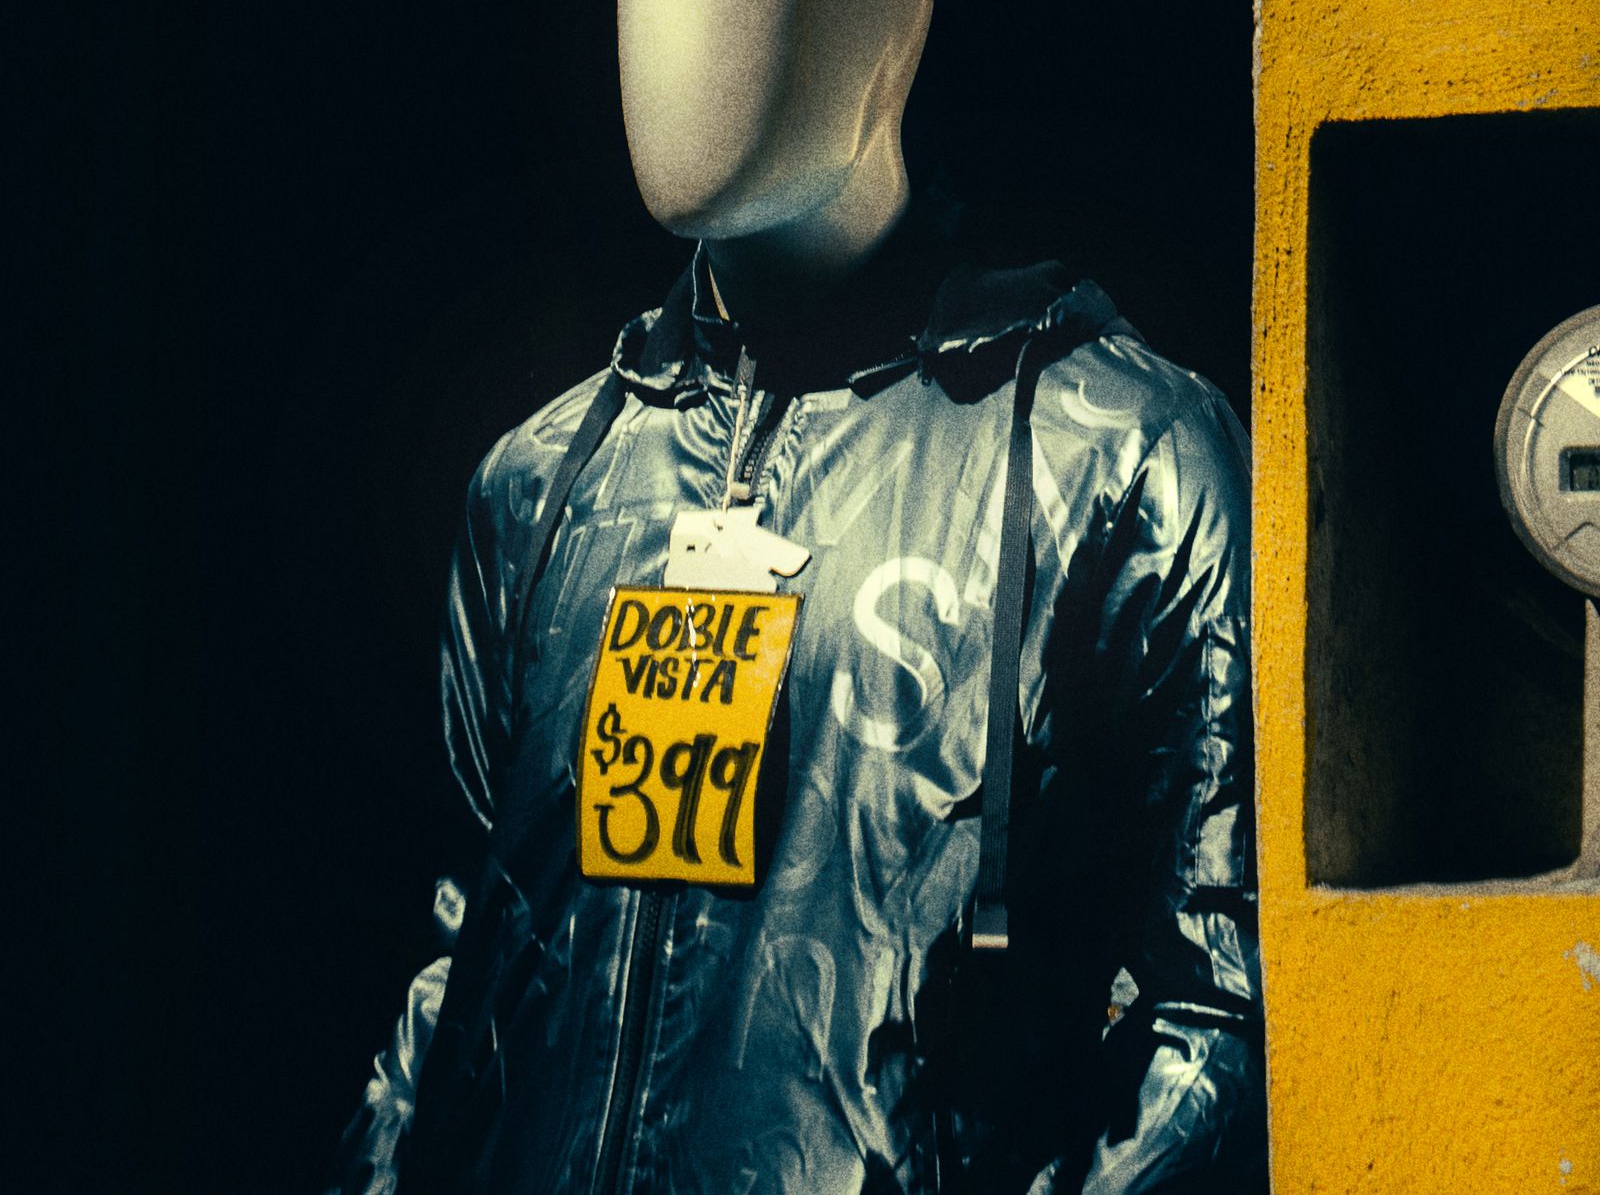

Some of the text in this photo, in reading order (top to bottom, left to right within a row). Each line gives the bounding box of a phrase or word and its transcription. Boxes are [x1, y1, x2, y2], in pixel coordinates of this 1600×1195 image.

[609, 600, 769, 660] DOBLE
[616, 655, 737, 704] VISTA
[831, 556, 959, 753] S
[591, 703, 760, 867] $399
